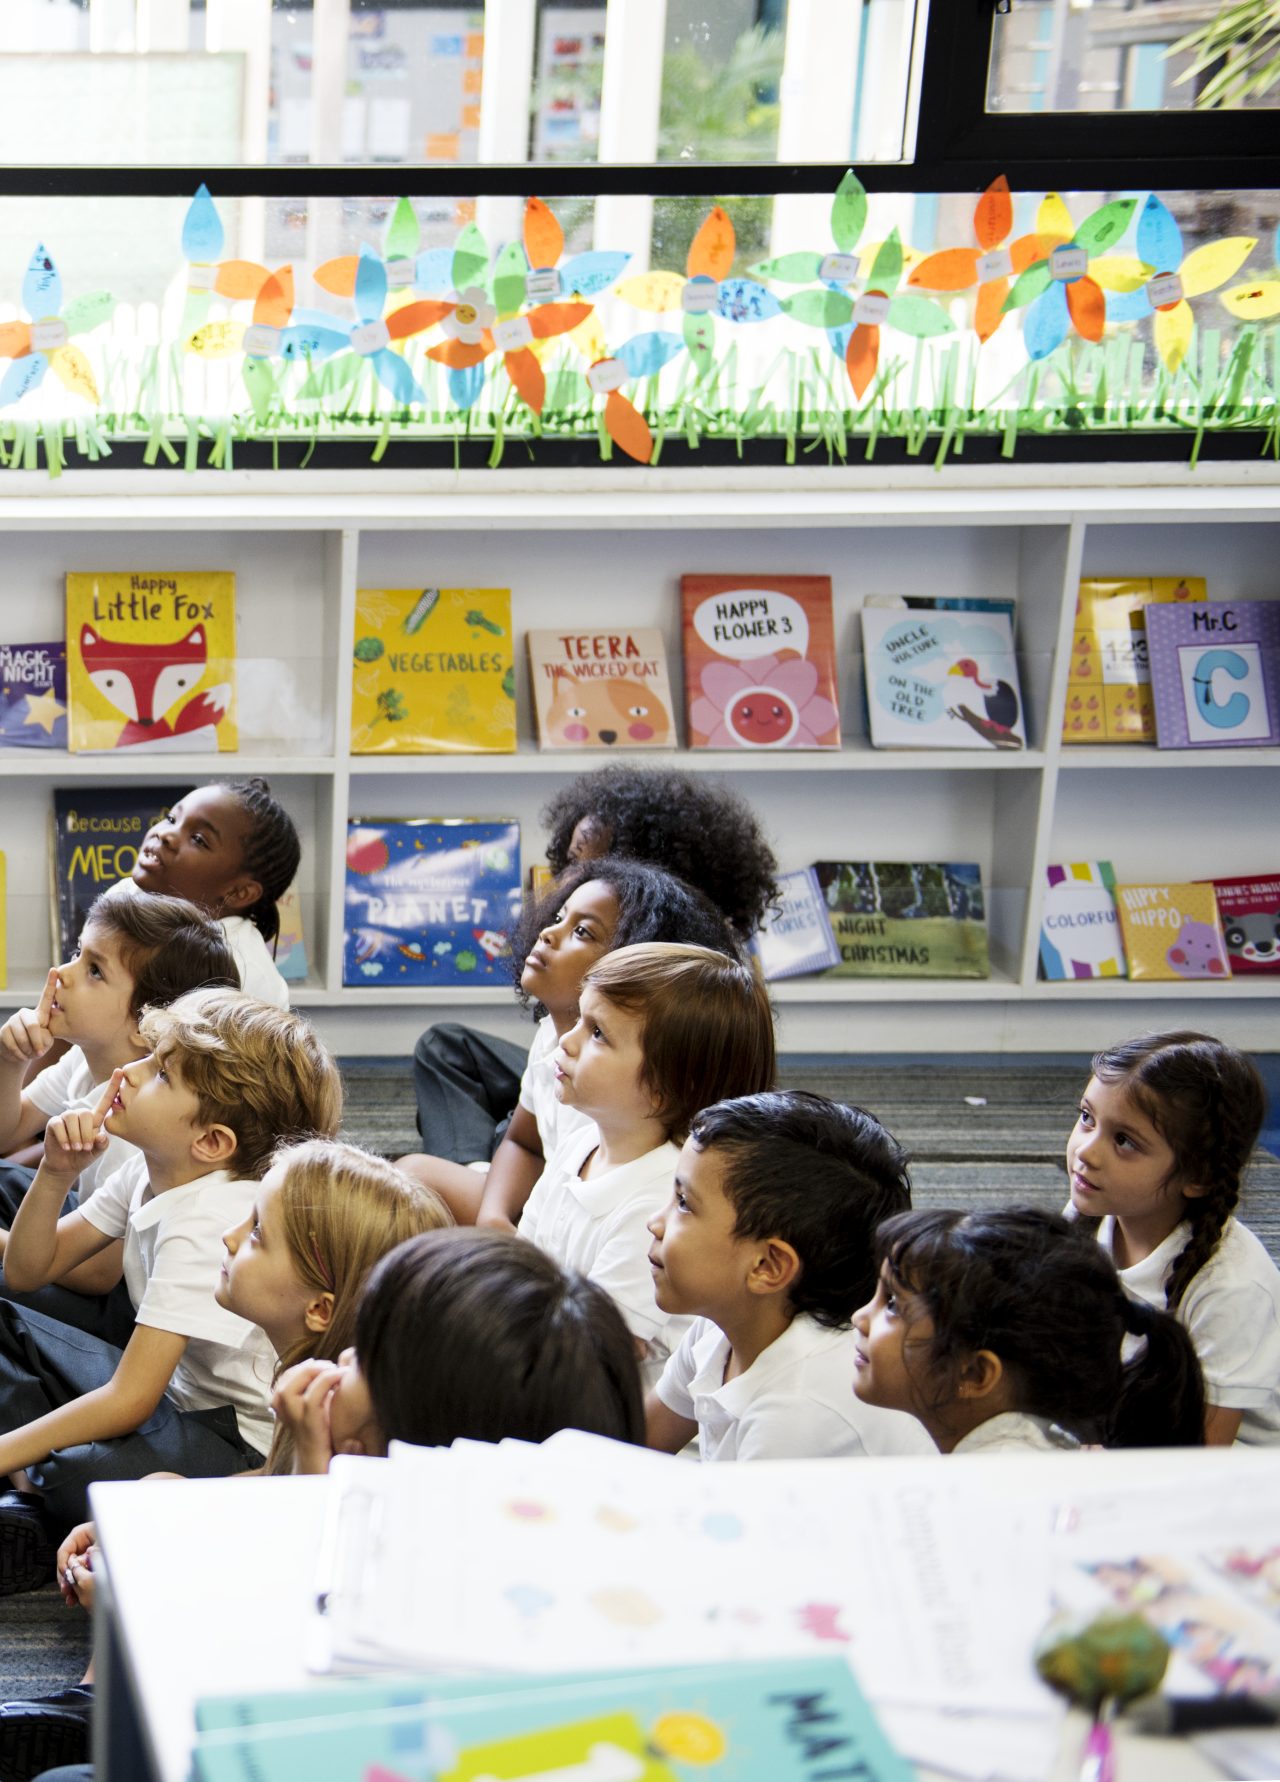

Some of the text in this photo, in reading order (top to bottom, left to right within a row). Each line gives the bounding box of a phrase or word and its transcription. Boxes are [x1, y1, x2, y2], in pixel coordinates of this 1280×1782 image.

[130, 575, 177, 596] Happy
[93, 591, 214, 622] Little Fox
[716, 599, 769, 620] HAPPY
[713, 617, 793, 641] FLOWER 3
[1193, 610, 1238, 632] Mr.C
[559, 635, 640, 660] TEERA
[886, 625, 929, 652] UNCLE
[892, 636, 938, 665] VULTURE
[4, 665, 56, 683] NIGHT
[387, 653, 503, 673] VEGETABLES
[543, 661, 659, 679] THE WICKED CAT
[888, 675, 935, 697] ON THE
[896, 691, 924, 706] OLD
[891, 701, 925, 721] TREE
[67, 810, 142, 833] Because
[68, 845, 140, 882] MEO
[1122, 887, 1170, 909] HIPPY
[368, 893, 488, 928] PLANET
[1047, 911, 1116, 929] COLORFU
[1129, 908, 1181, 928] HIPPO
[838, 918, 886, 935] NIGHT
[841, 944, 929, 964] CHRISTMAS
[765, 1691, 875, 1782] MAT
